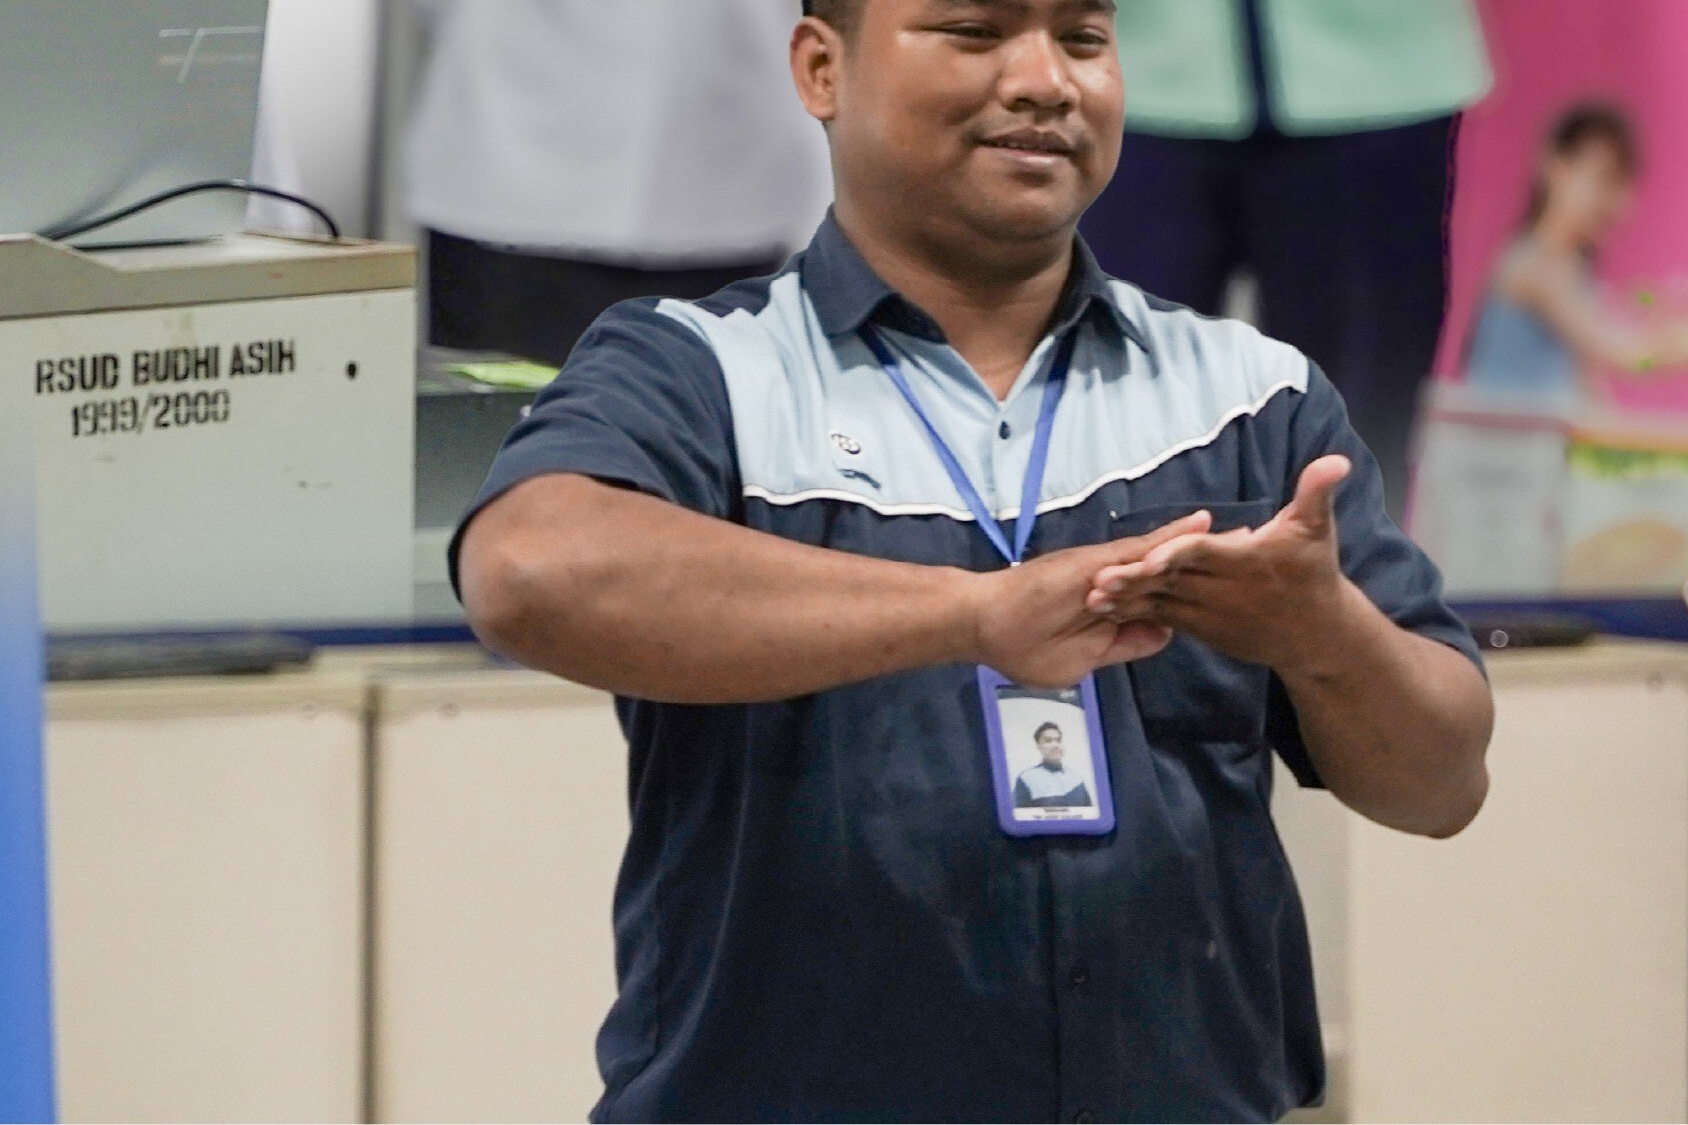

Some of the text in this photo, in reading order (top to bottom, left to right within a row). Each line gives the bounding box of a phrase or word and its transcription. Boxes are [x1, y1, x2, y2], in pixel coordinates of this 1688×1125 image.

[35, 339, 297, 394] RSUD BUDHI ASIH
[71, 389, 231, 436] 1999/2000
